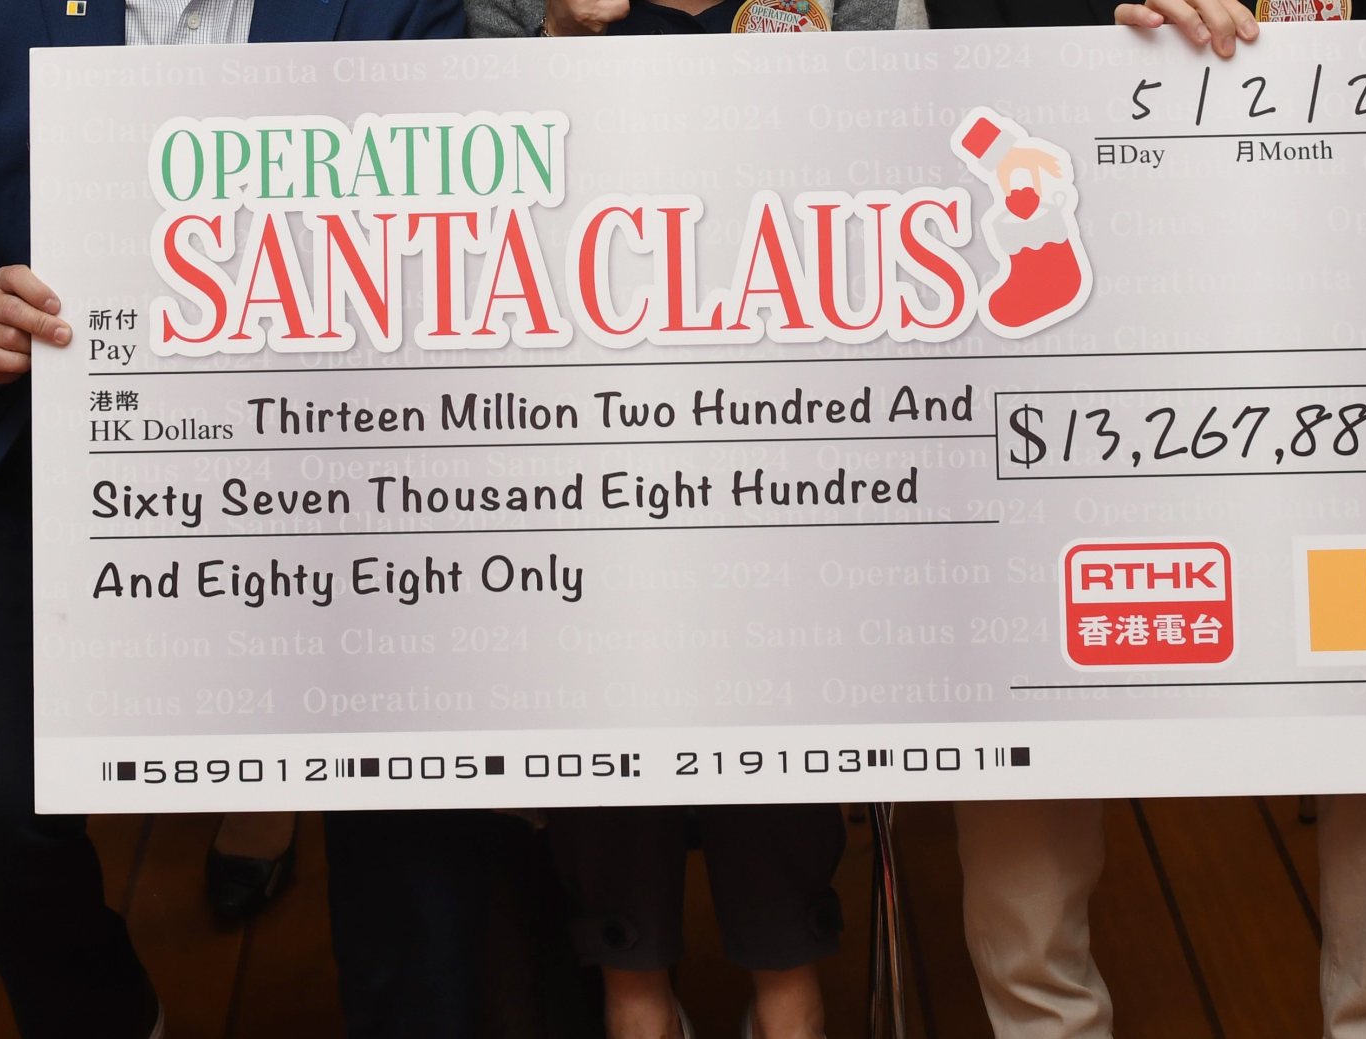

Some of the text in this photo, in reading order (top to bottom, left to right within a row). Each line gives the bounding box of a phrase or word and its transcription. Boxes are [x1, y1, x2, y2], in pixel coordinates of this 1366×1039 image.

[751, 5, 800, 24] OPERATION
[333, 55, 428, 83] Claus
[442, 53, 522, 81] 2024
[731, 47, 830, 75] Santa
[844, 44, 940, 73] Claus
[953, 42, 1033, 70] 2024
[1132, 80, 1161, 120] 5
[1242, 77, 1276, 117] 2
[162, 124, 555, 202] OPERATION
[163, 200, 965, 342] SANTA CLAUS
[90, 309, 137, 330] 祈付
[91, 340, 135, 365] Pay
[90, 391, 138, 411] 港幣
[91, 420, 133, 441] HK
[144, 419, 233, 440] Dollars
[248, 397, 424, 434] Thirteen
[442, 393, 577, 431] Million
[594, 392, 675, 427] Two
[693, 387, 870, 425] Hundred
[889, 385, 972, 422] And
[92, 481, 202, 528] Sixty
[222, 478, 349, 516] Seven
[368, 473, 582, 513] Thousand
[603, 471, 712, 519] Eight
[732, 467, 917, 506] Hundred
[93, 554, 582, 608] And Eighty Eight Only
[819, 557, 992, 592] Operation
[1080, 562, 1217, 591] RTHK
[227, 628, 326, 657] Santa
[341, 626, 437, 655] Claus
[450, 624, 530, 653] 2024
[745, 618, 844, 648] Santa
[858, 616, 956, 646] Claus
[969, 615, 1051, 644] 2024
[1078, 613, 1223, 648] 香港電台
[86, 688, 182, 718] Claus
[195, 686, 276, 716] 2024
[302, 683, 475, 719] Operation
[490, 681, 589, 711] Santa
[714, 677, 795, 707] 2024
[821, 674, 996, 710] Operation
